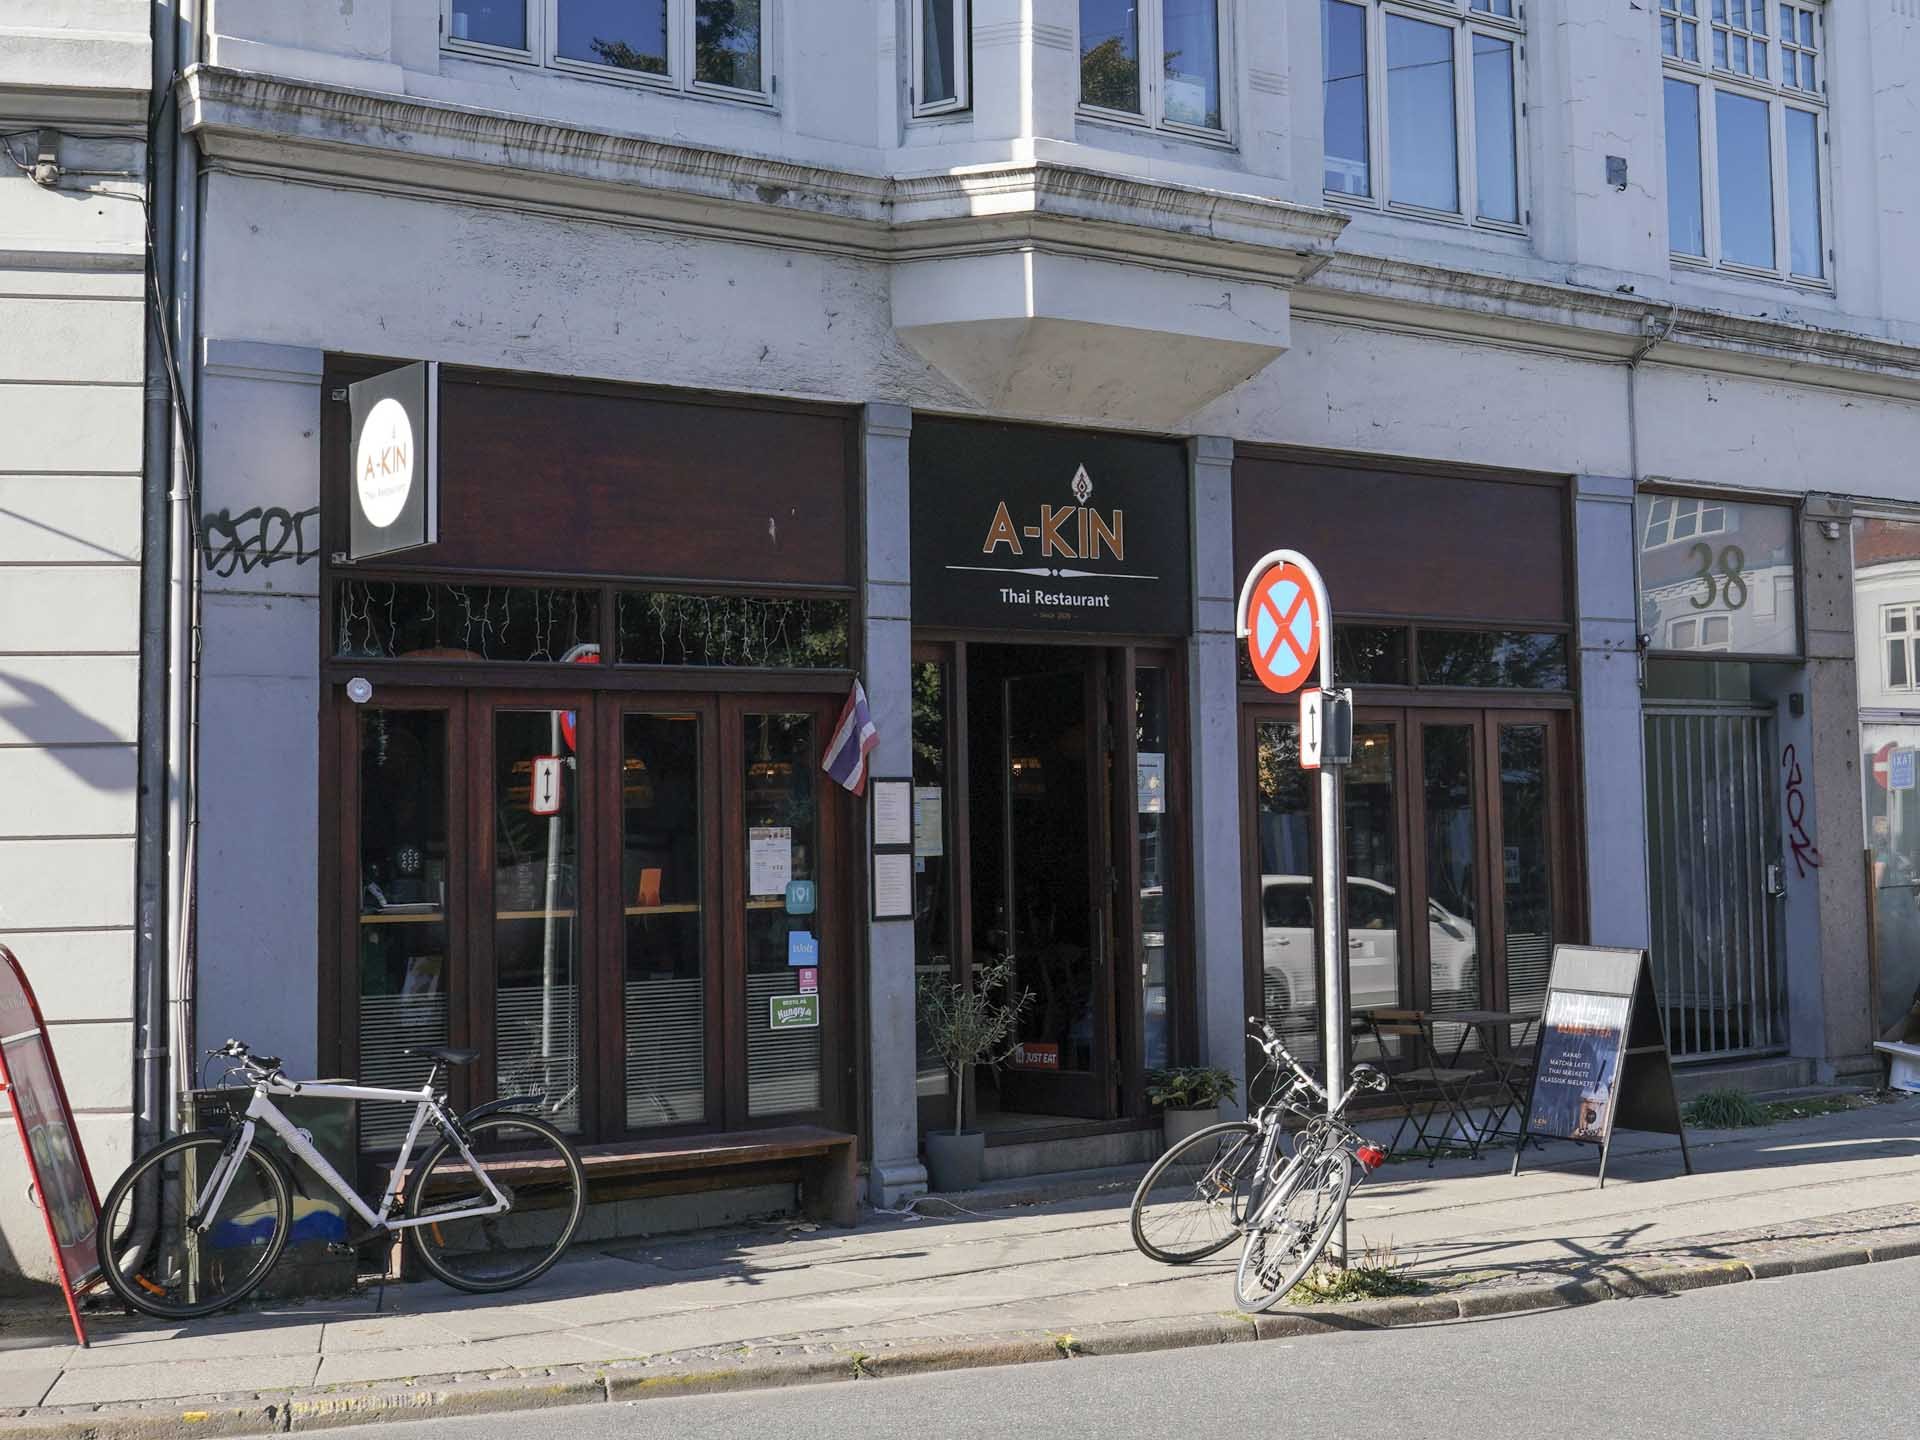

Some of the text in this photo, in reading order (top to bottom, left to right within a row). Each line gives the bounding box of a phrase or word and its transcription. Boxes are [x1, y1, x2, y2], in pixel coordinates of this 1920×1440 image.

[364, 442, 407, 481] A-KIN
[982, 501, 1124, 561] A-KIN
[1688, 542, 1748, 610] 38
[1000, 588, 1110, 607] Thai Restaurant
[1025, 1052, 1056, 1064] JUST EAT
[1550, 1059, 1573, 1067] MATCHA
